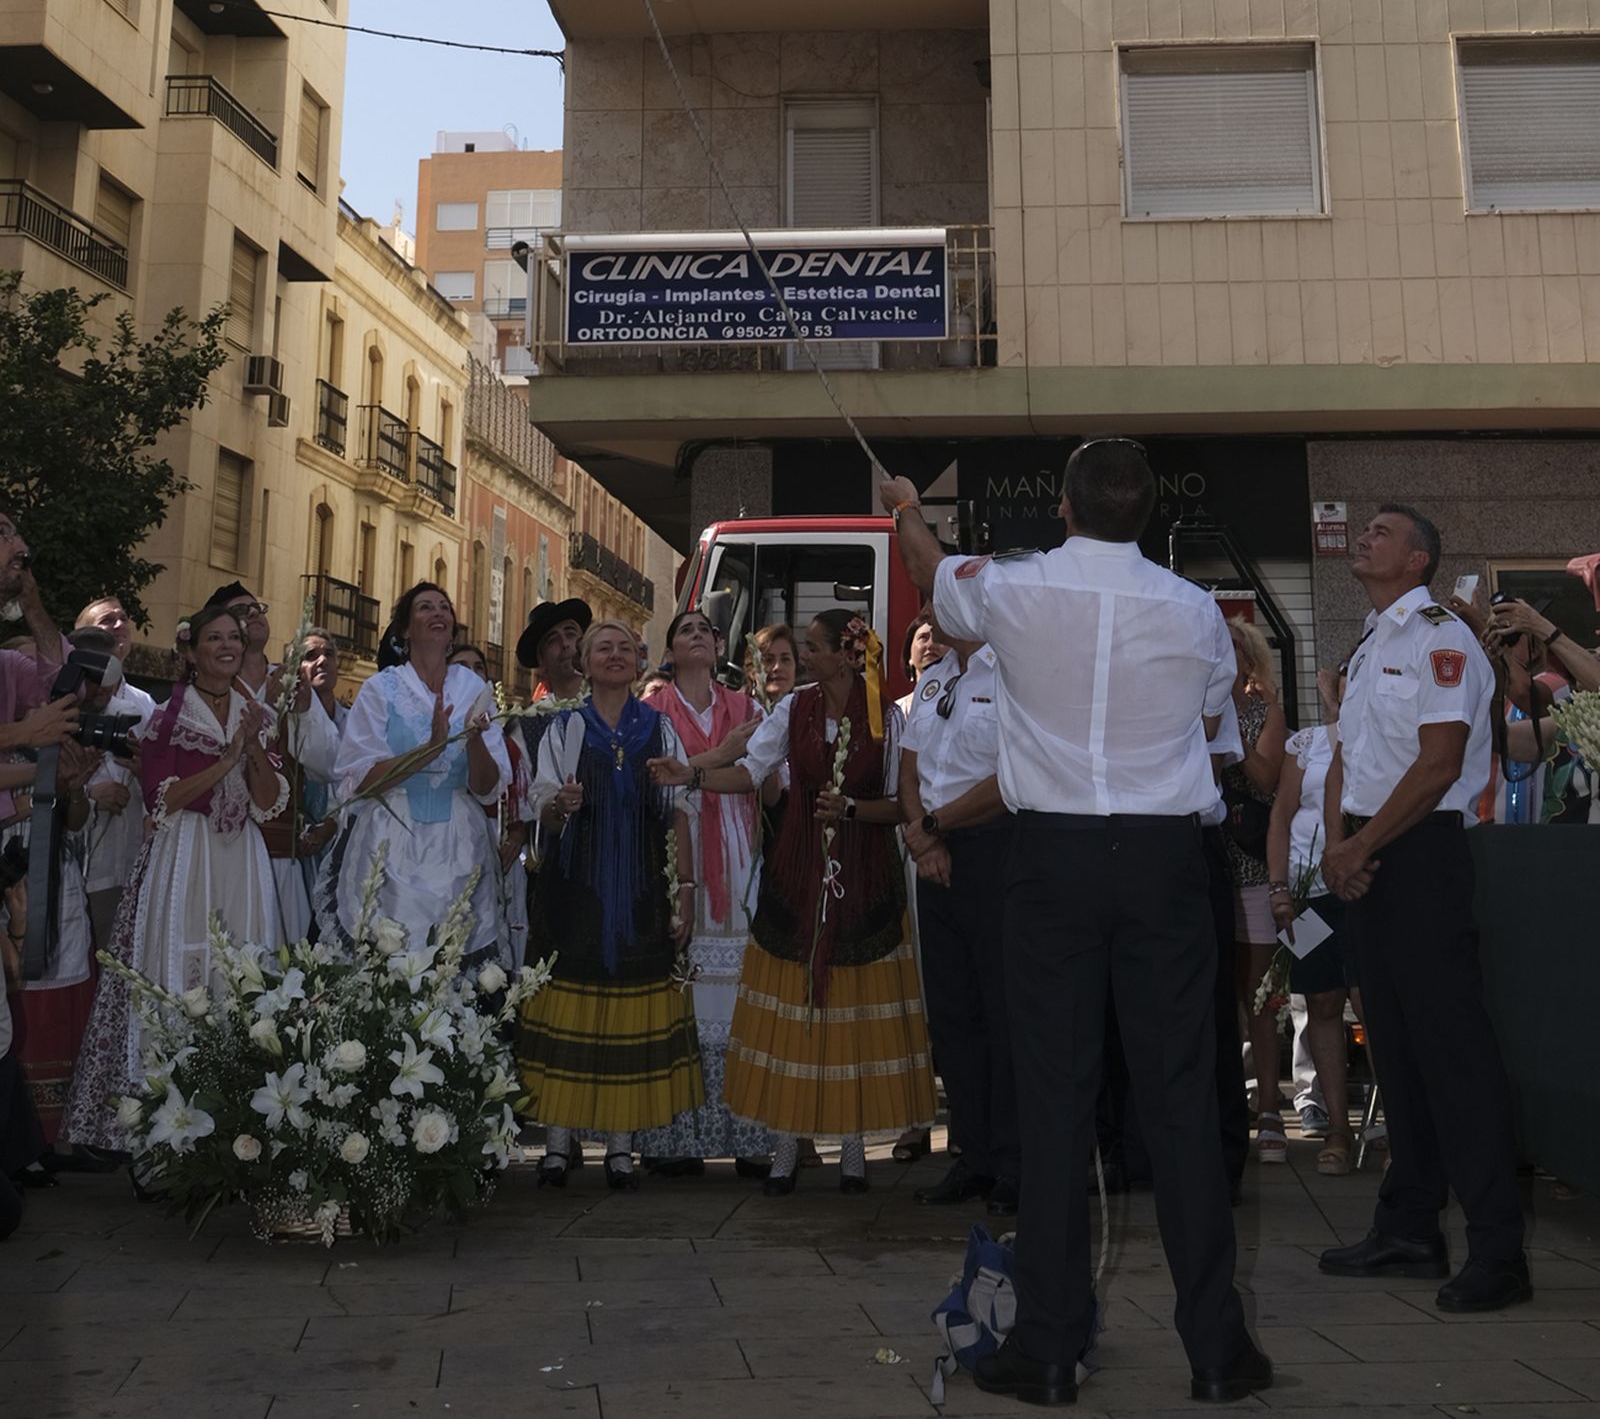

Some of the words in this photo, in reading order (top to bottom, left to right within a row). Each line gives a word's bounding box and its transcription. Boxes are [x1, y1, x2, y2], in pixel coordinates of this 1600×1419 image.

[582, 254, 749, 281] CLINICA
[768, 251, 933, 278] DENTAL
[574, 289, 646, 305] Cirugía
[665, 287, 765, 304] Implantes
[783, 286, 868, 300] Estetica
[875, 284, 940, 299] Dental
[641, 309, 746, 326] Alejandro
[758, 307, 812, 322] Caba
[821, 306, 918, 321] Calvache
[577, 326, 709, 341] ORTODONCIA
